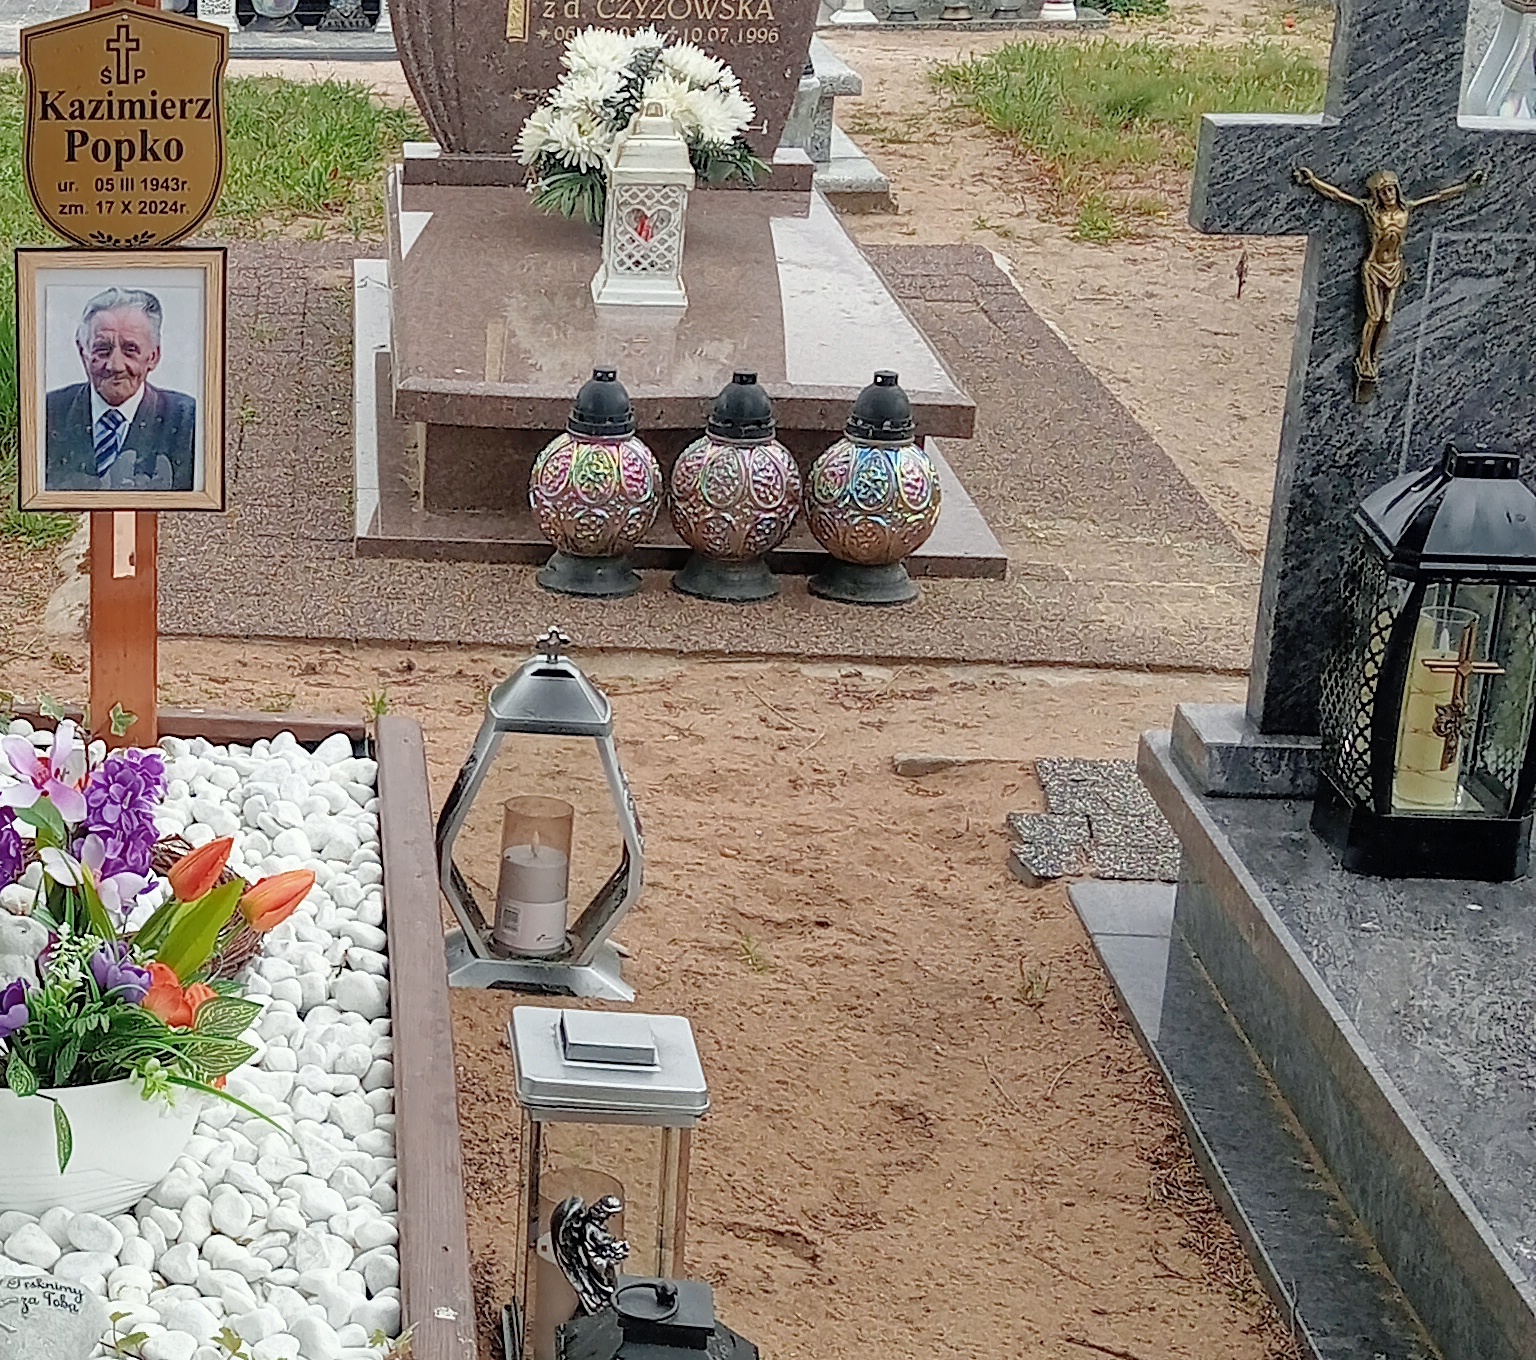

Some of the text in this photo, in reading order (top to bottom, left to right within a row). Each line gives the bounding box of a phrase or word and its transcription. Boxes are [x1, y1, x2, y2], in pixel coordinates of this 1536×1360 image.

[38, 90, 212, 121] Kazimierz
[64, 129, 185, 172] Popko
[57, 177, 191, 192] ur. 05 III 1943r.
[58, 200, 190, 215] zm. 17 X 2024r.
